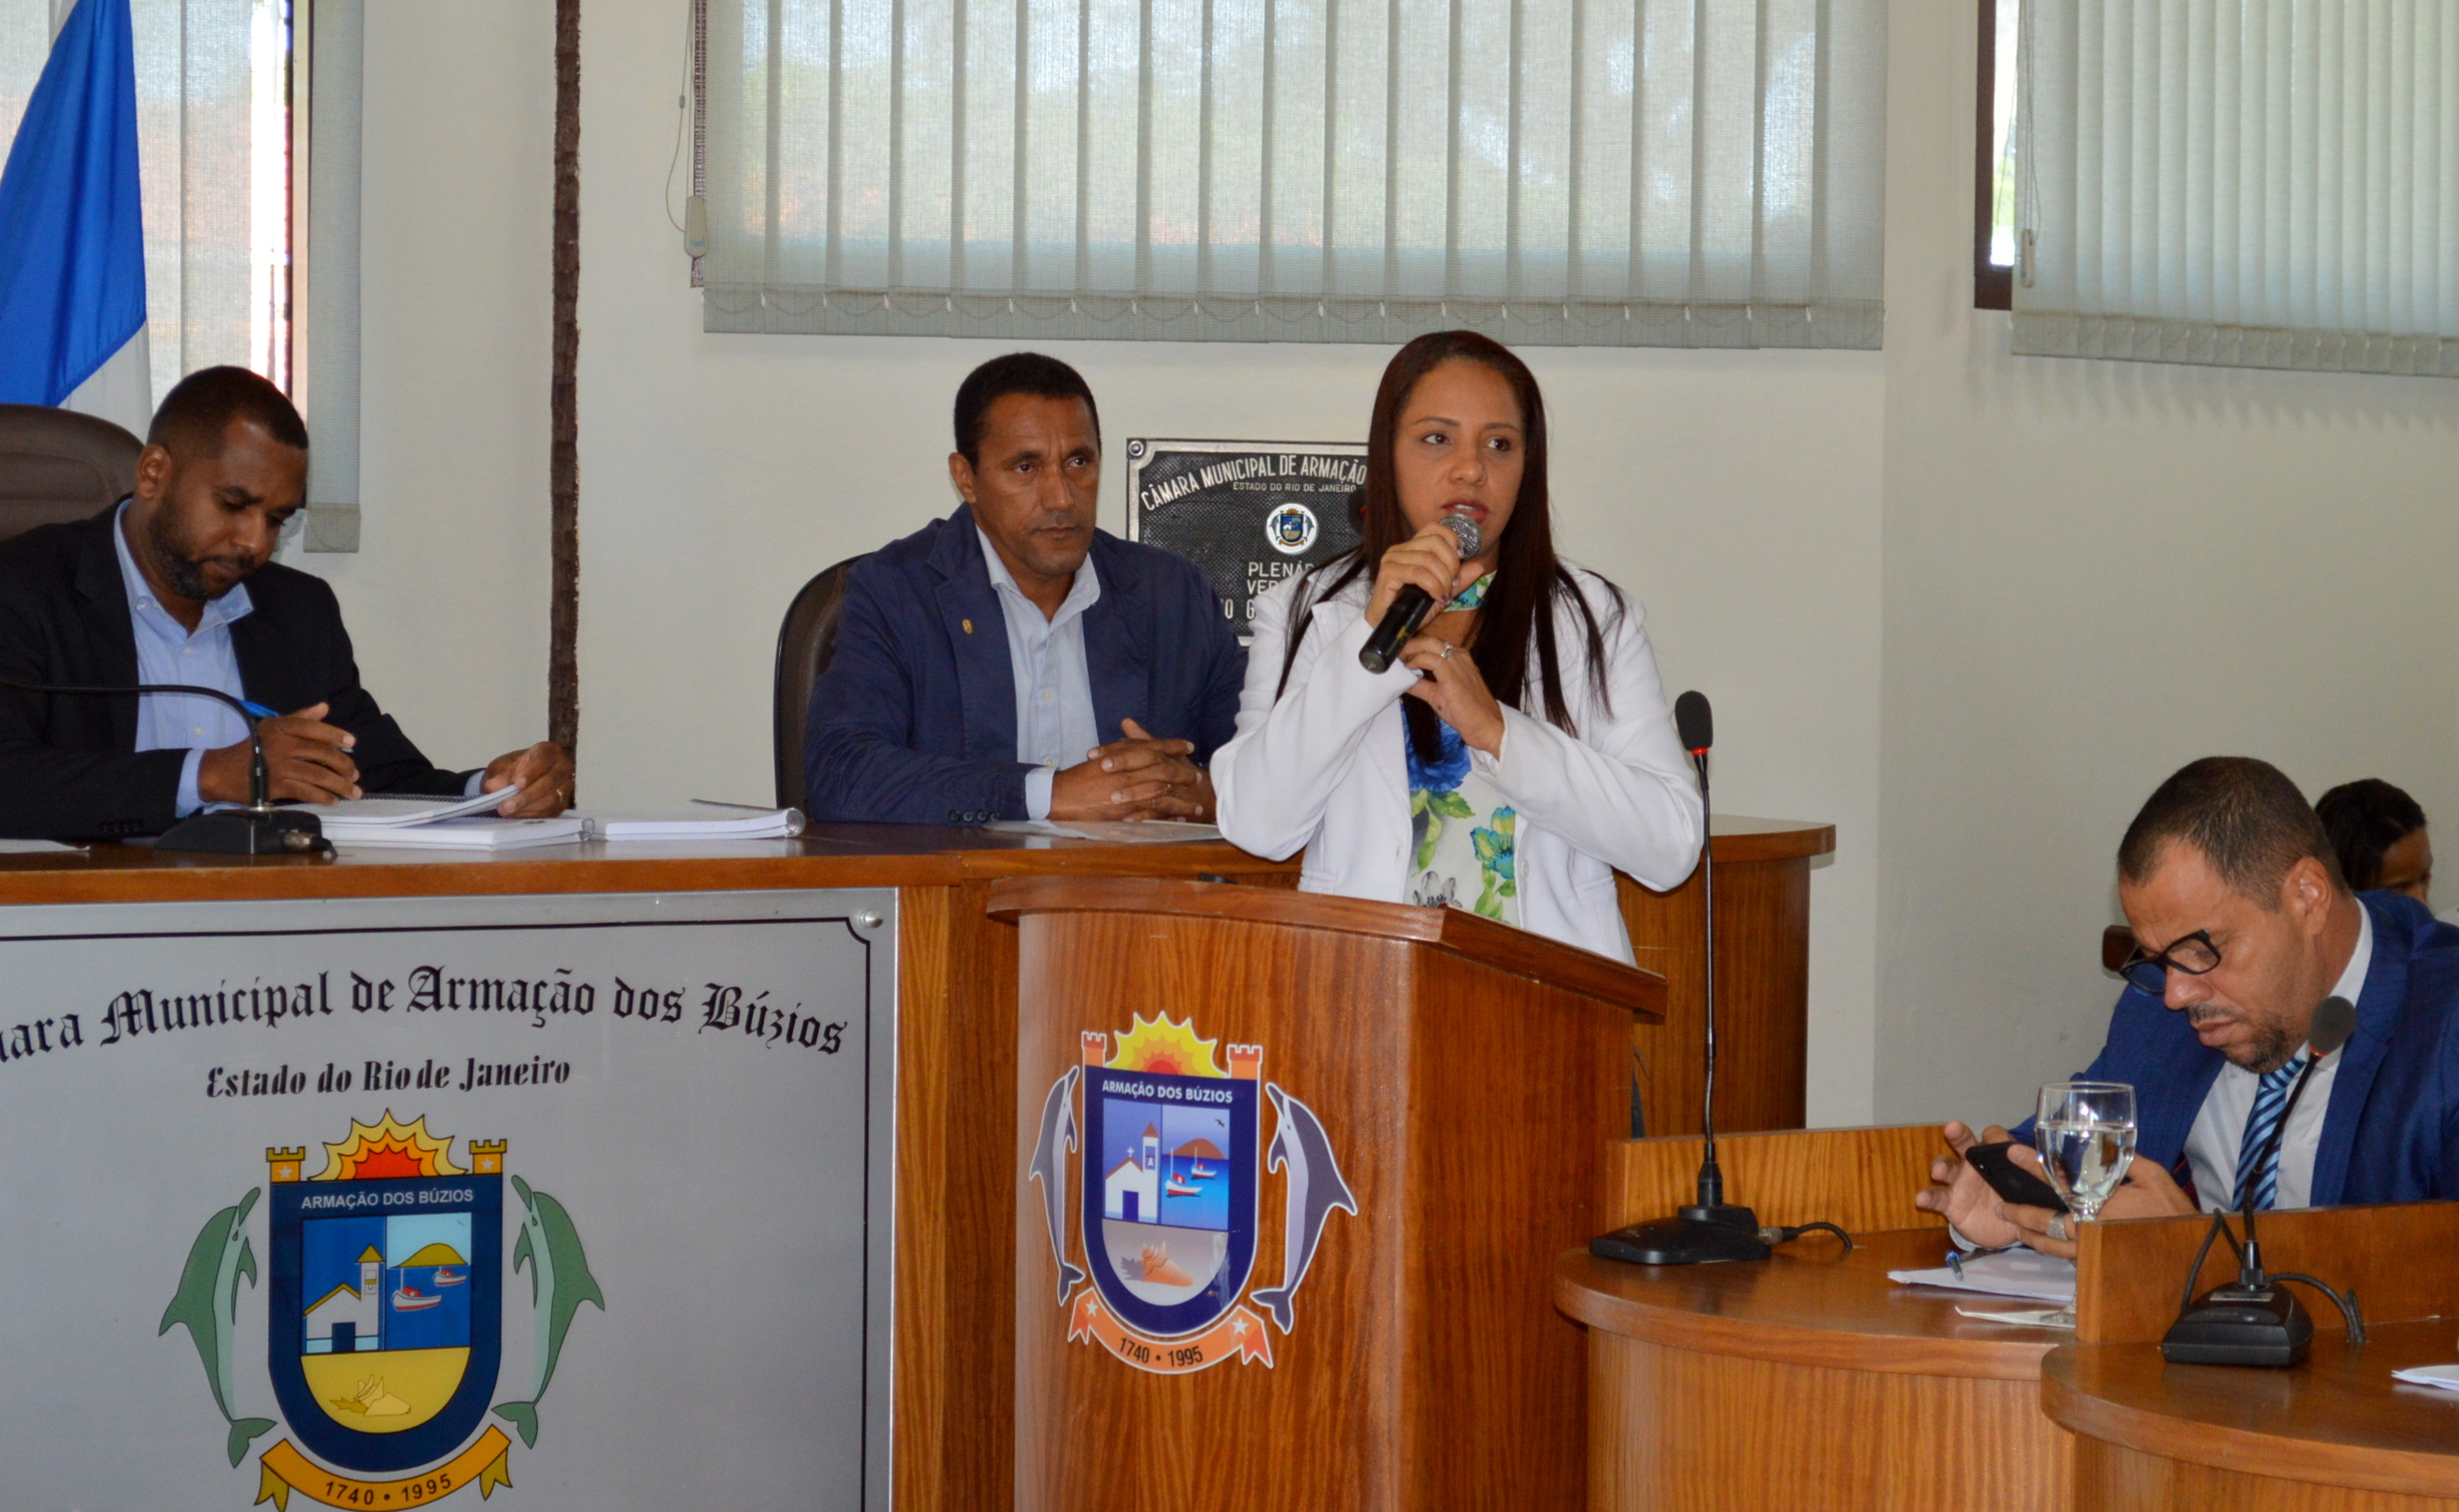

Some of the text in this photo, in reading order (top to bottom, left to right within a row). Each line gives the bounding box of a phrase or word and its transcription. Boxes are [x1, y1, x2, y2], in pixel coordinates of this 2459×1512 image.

[1140, 455, 1367, 511] CÂMARA MUNICIPAL DE ARMAÇÃO
[1233, 482, 1356, 493] ESTADO DO RIO DE JANEIRO
[100, 970, 334, 1047] Municipal
[350, 970, 395, 1013] de
[407, 965, 596, 1028] Armação
[612, 976, 686, 1023] dos
[698, 982, 848, 1055] Búzios
[206, 1055, 570, 1098] Estado do Rio de Janeiro
[1102, 1080, 1233, 1104] ARMAÇÃO DOS BÚZIOS
[301, 1188, 474, 1210] ARMAÇÃO DOS BÚZIOS
[1120, 1337, 1203, 1367] 1740 1995
[325, 1473, 451, 1505] 1740 1995
